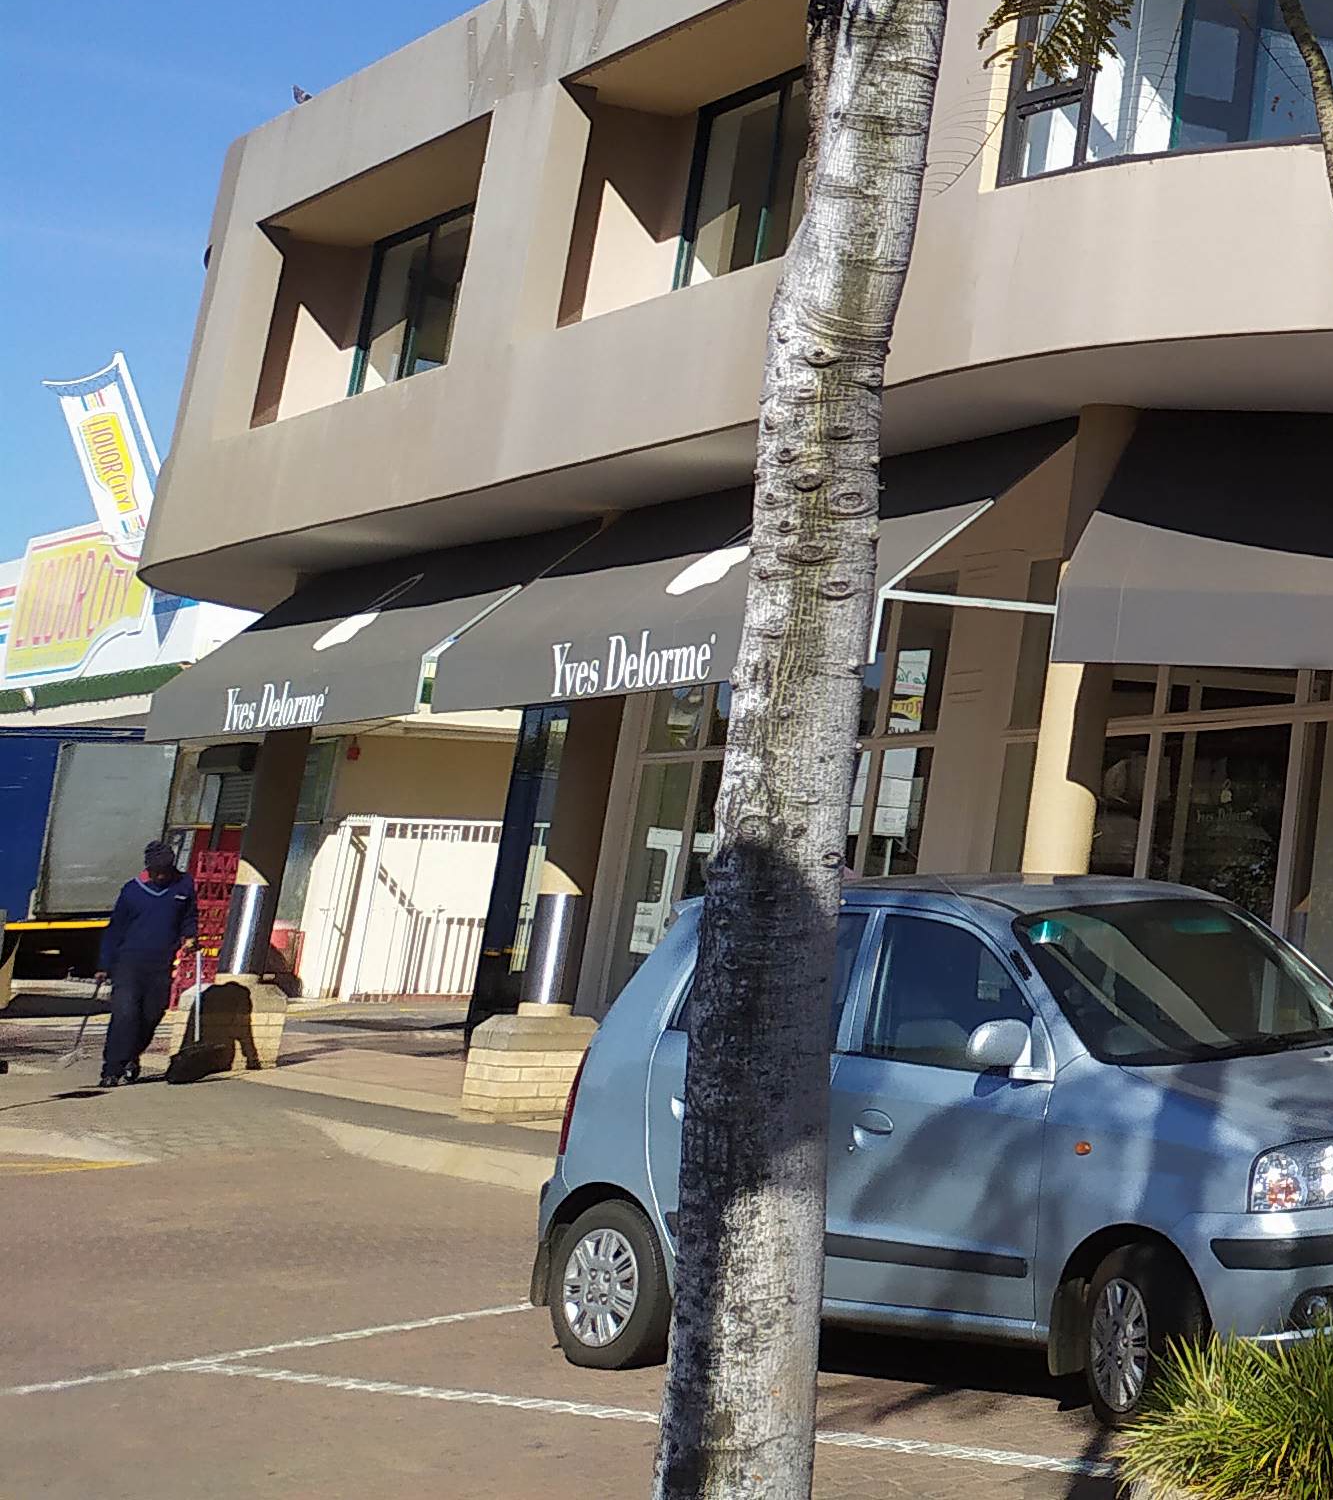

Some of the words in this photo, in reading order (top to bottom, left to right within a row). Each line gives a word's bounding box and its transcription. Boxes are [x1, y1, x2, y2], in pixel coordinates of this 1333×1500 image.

[87, 419, 124, 476] LIQUOR
[106, 473, 131, 505] CITY
[15, 550, 95, 648] LIQUOR
[86, 552, 134, 638] CITY
[550, 643, 600, 698] Yves
[603, 631, 712, 692] Delorme
[223, 687, 257, 731] Yves
[256, 681, 325, 728] Delorme
